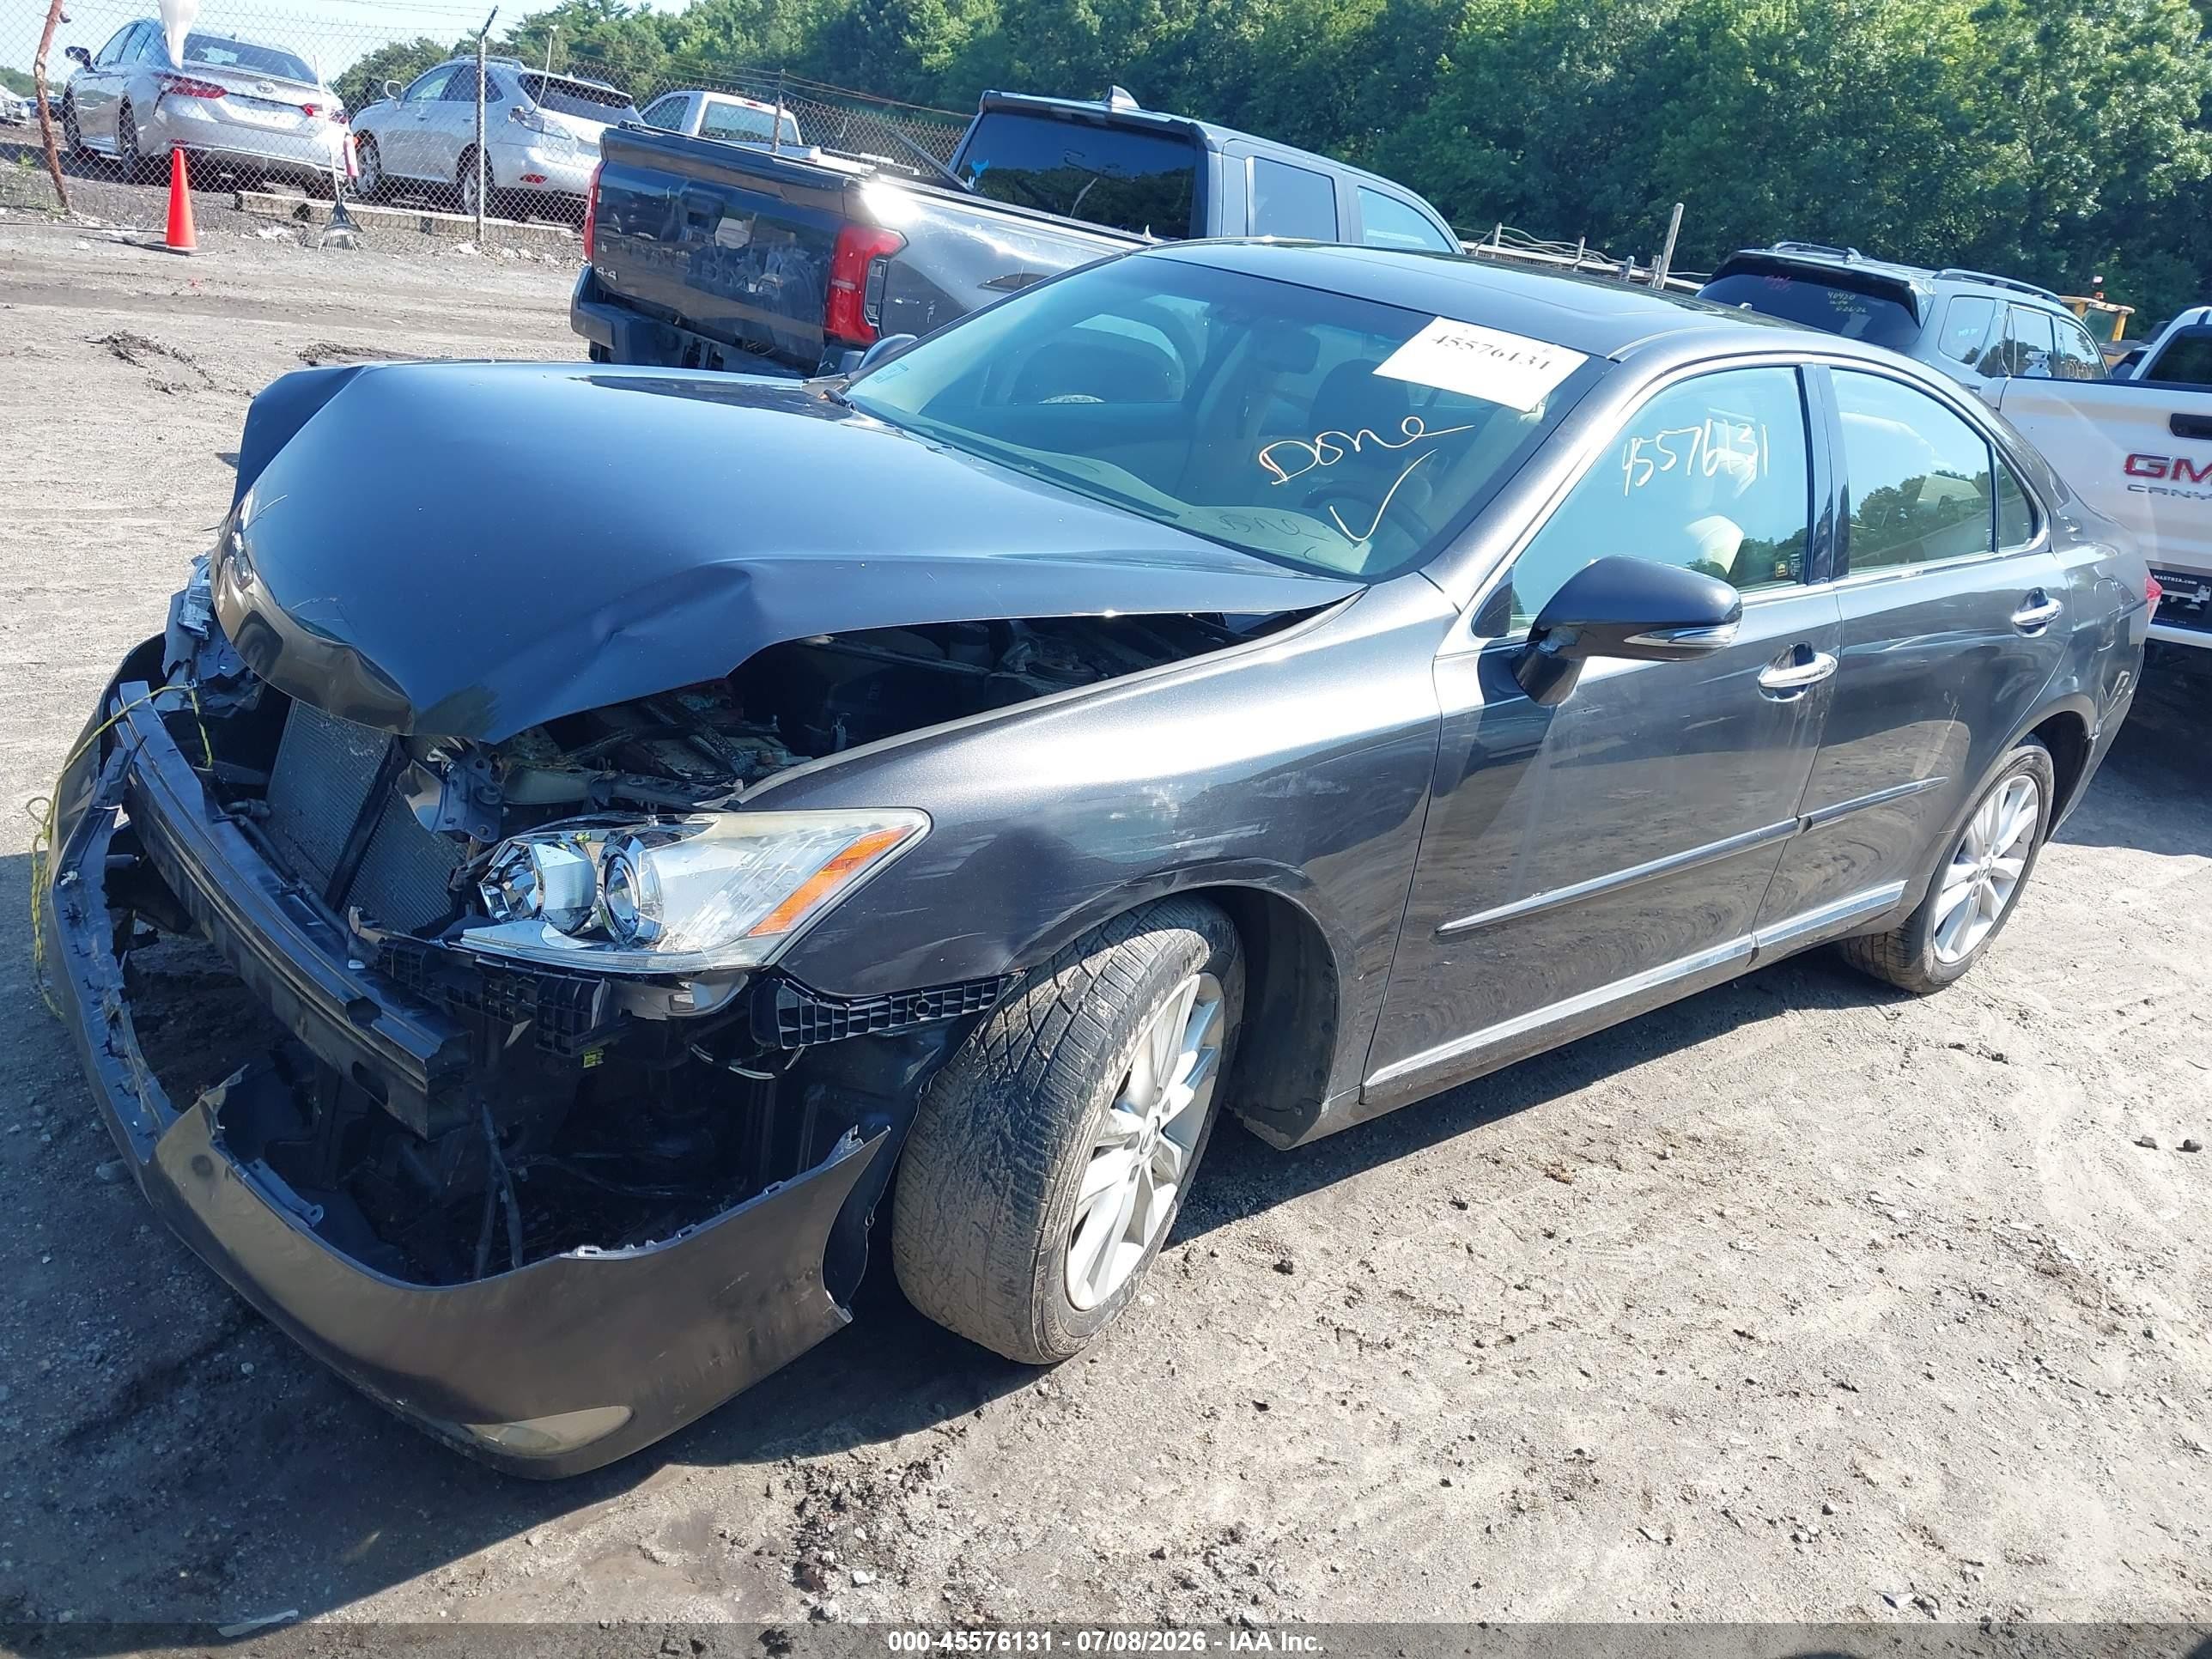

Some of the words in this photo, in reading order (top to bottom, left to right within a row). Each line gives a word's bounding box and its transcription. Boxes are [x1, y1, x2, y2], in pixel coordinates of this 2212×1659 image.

[1431, 333, 1551, 370] 45576131
[1258, 416, 1476, 485] Done
[1622, 417, 1769, 497] 45576131
